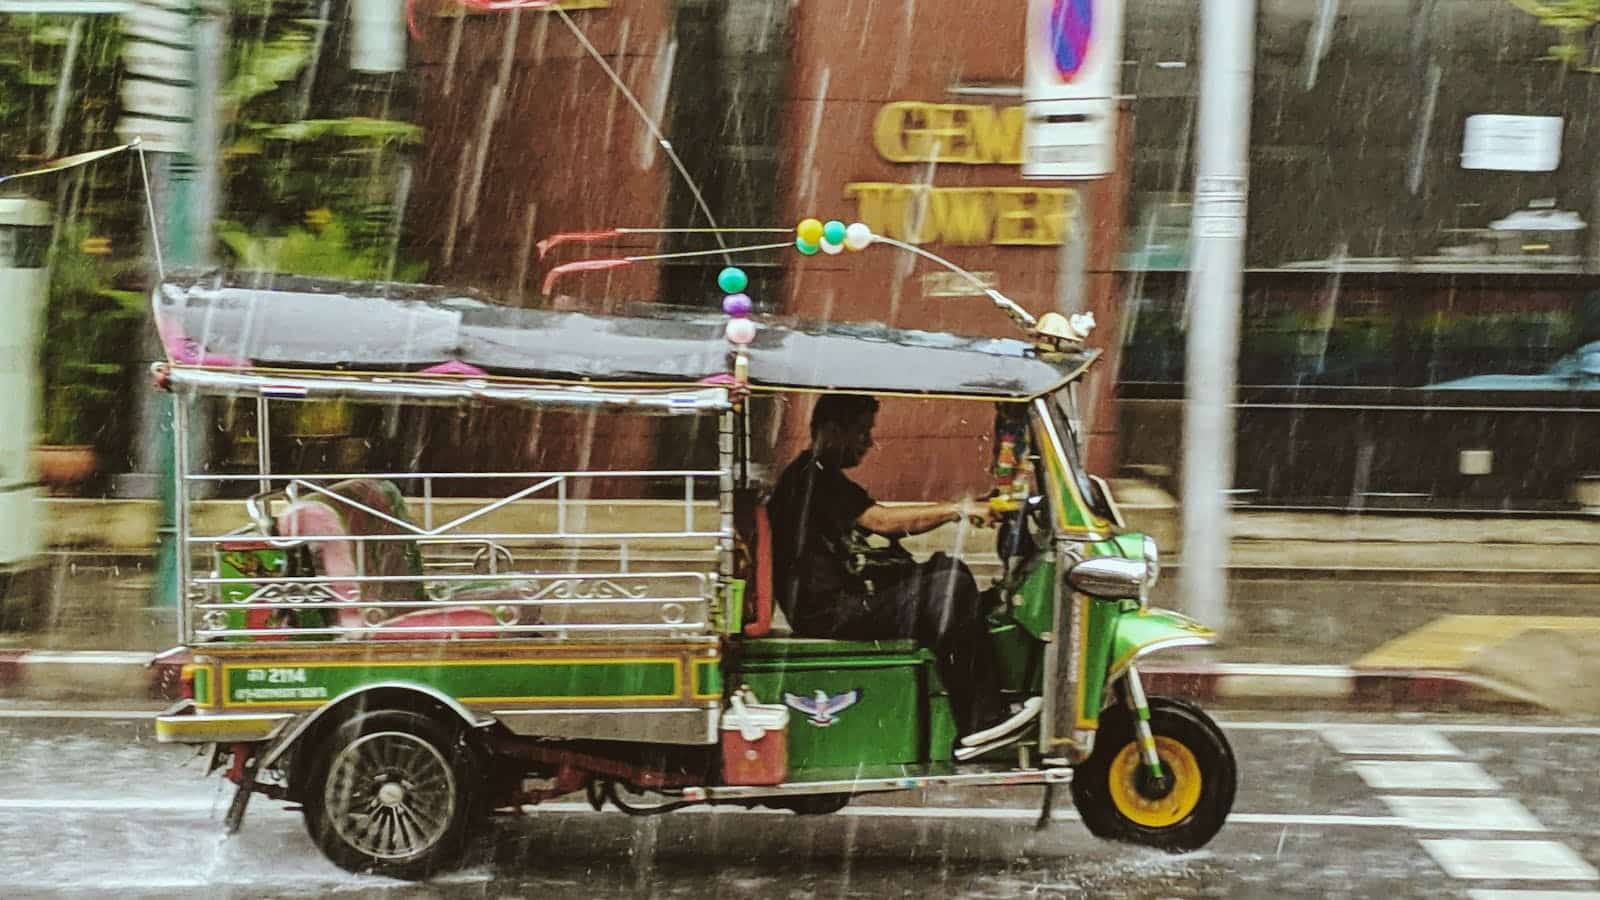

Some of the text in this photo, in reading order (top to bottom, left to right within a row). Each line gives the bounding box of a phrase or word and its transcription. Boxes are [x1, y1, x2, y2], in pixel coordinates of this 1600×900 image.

[873, 101, 1025, 164] GEM
[845, 182, 1080, 247] TOWER
[268, 668, 307, 683] 2114
